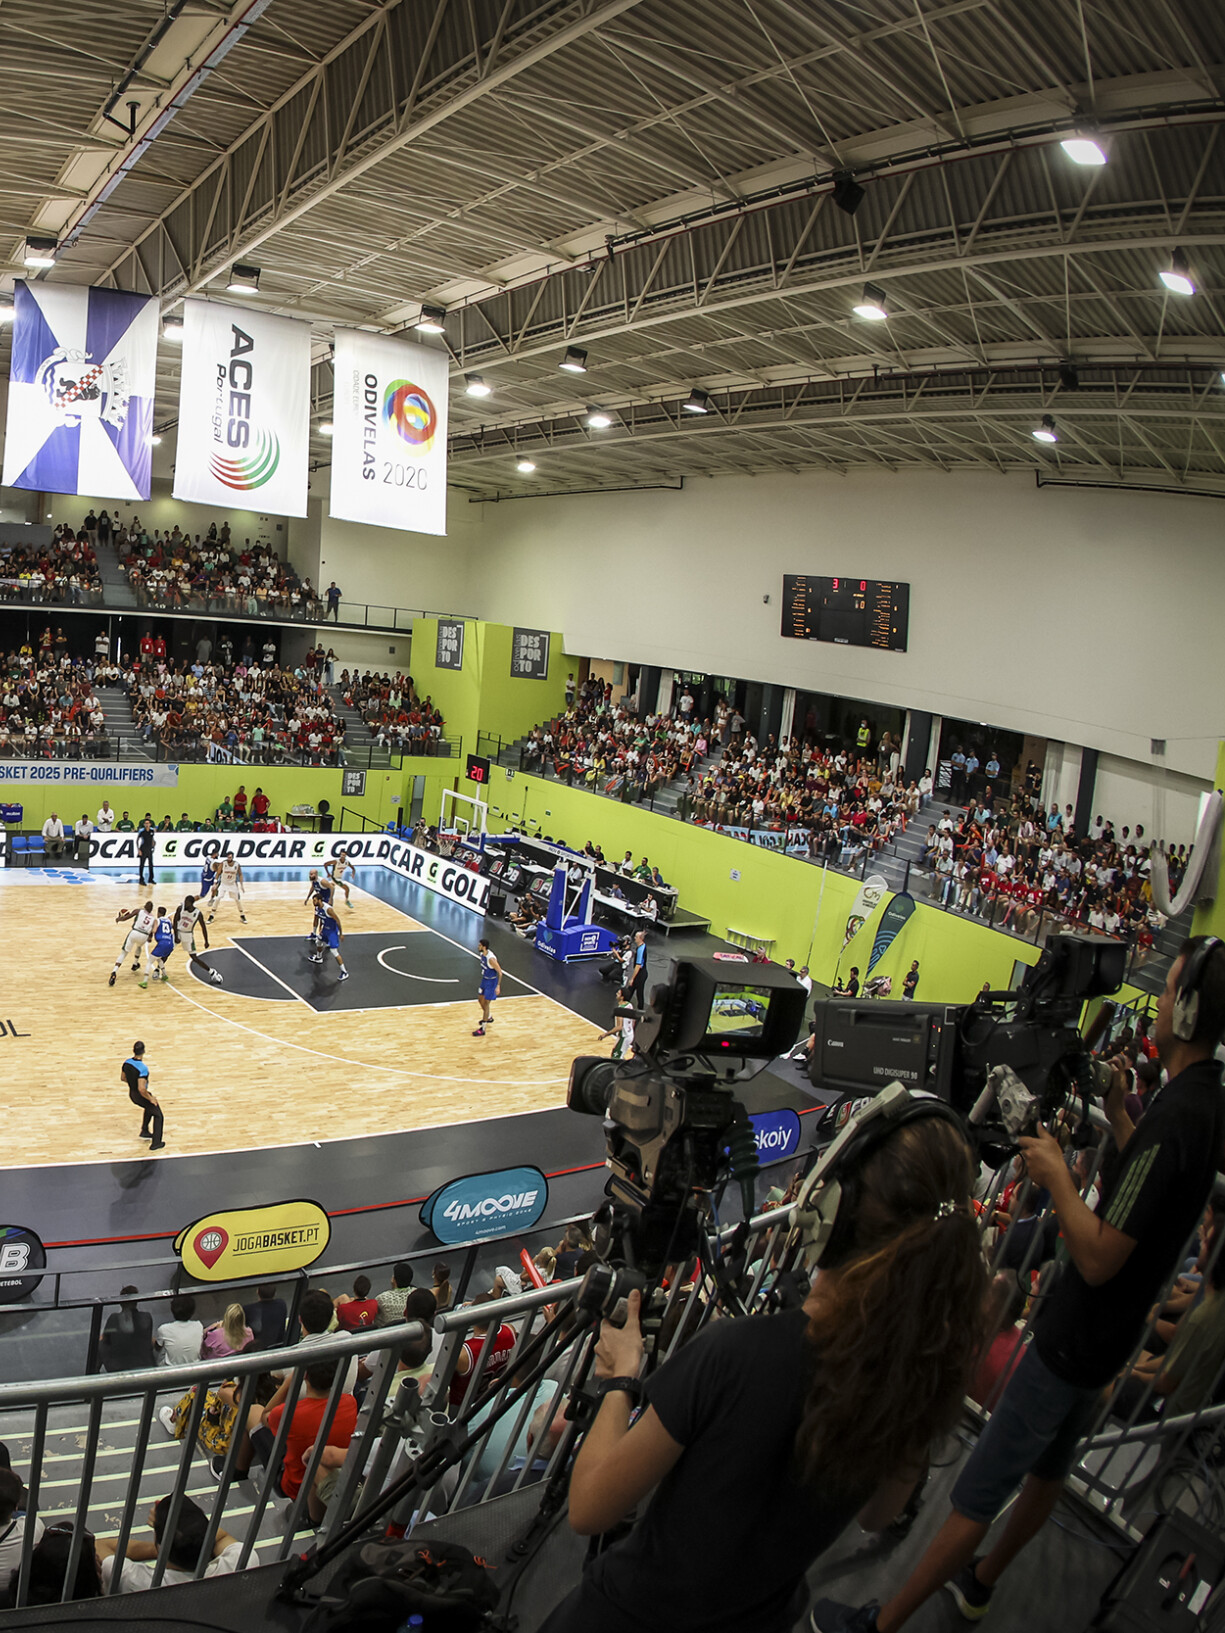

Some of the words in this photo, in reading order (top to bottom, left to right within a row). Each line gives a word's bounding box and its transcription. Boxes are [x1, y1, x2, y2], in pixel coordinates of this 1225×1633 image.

[227, 323, 254, 448] ACES
[212, 364, 226, 443] Portugal
[362, 373, 378, 480] ODIVELAS
[383, 462, 428, 490] 2020
[442, 626, 456, 638] DES
[442, 638, 458, 651] POR
[520, 634, 540, 648] DES
[441, 651, 451, 663] TO
[520, 648, 541, 661] POR
[520, 660, 532, 672] TO
[30, 767, 60, 780] 2025
[63, 767, 154, 781] PRE-QUALIFIERS
[470, 765, 484, 781] 20
[165, 840, 177, 853] G
[184, 840, 306, 858] GOLDCAR
[314, 841, 324, 853] G
[143, 916, 150, 925] 5
[537, 940, 556, 954] Odivelas
[828, 1039, 844, 1047] Canon
[873, 1067, 884, 1075] UHD
[443, 1190, 538, 1221] 4MOOVE
[233, 1228, 319, 1252] JOGABASKET.PT
